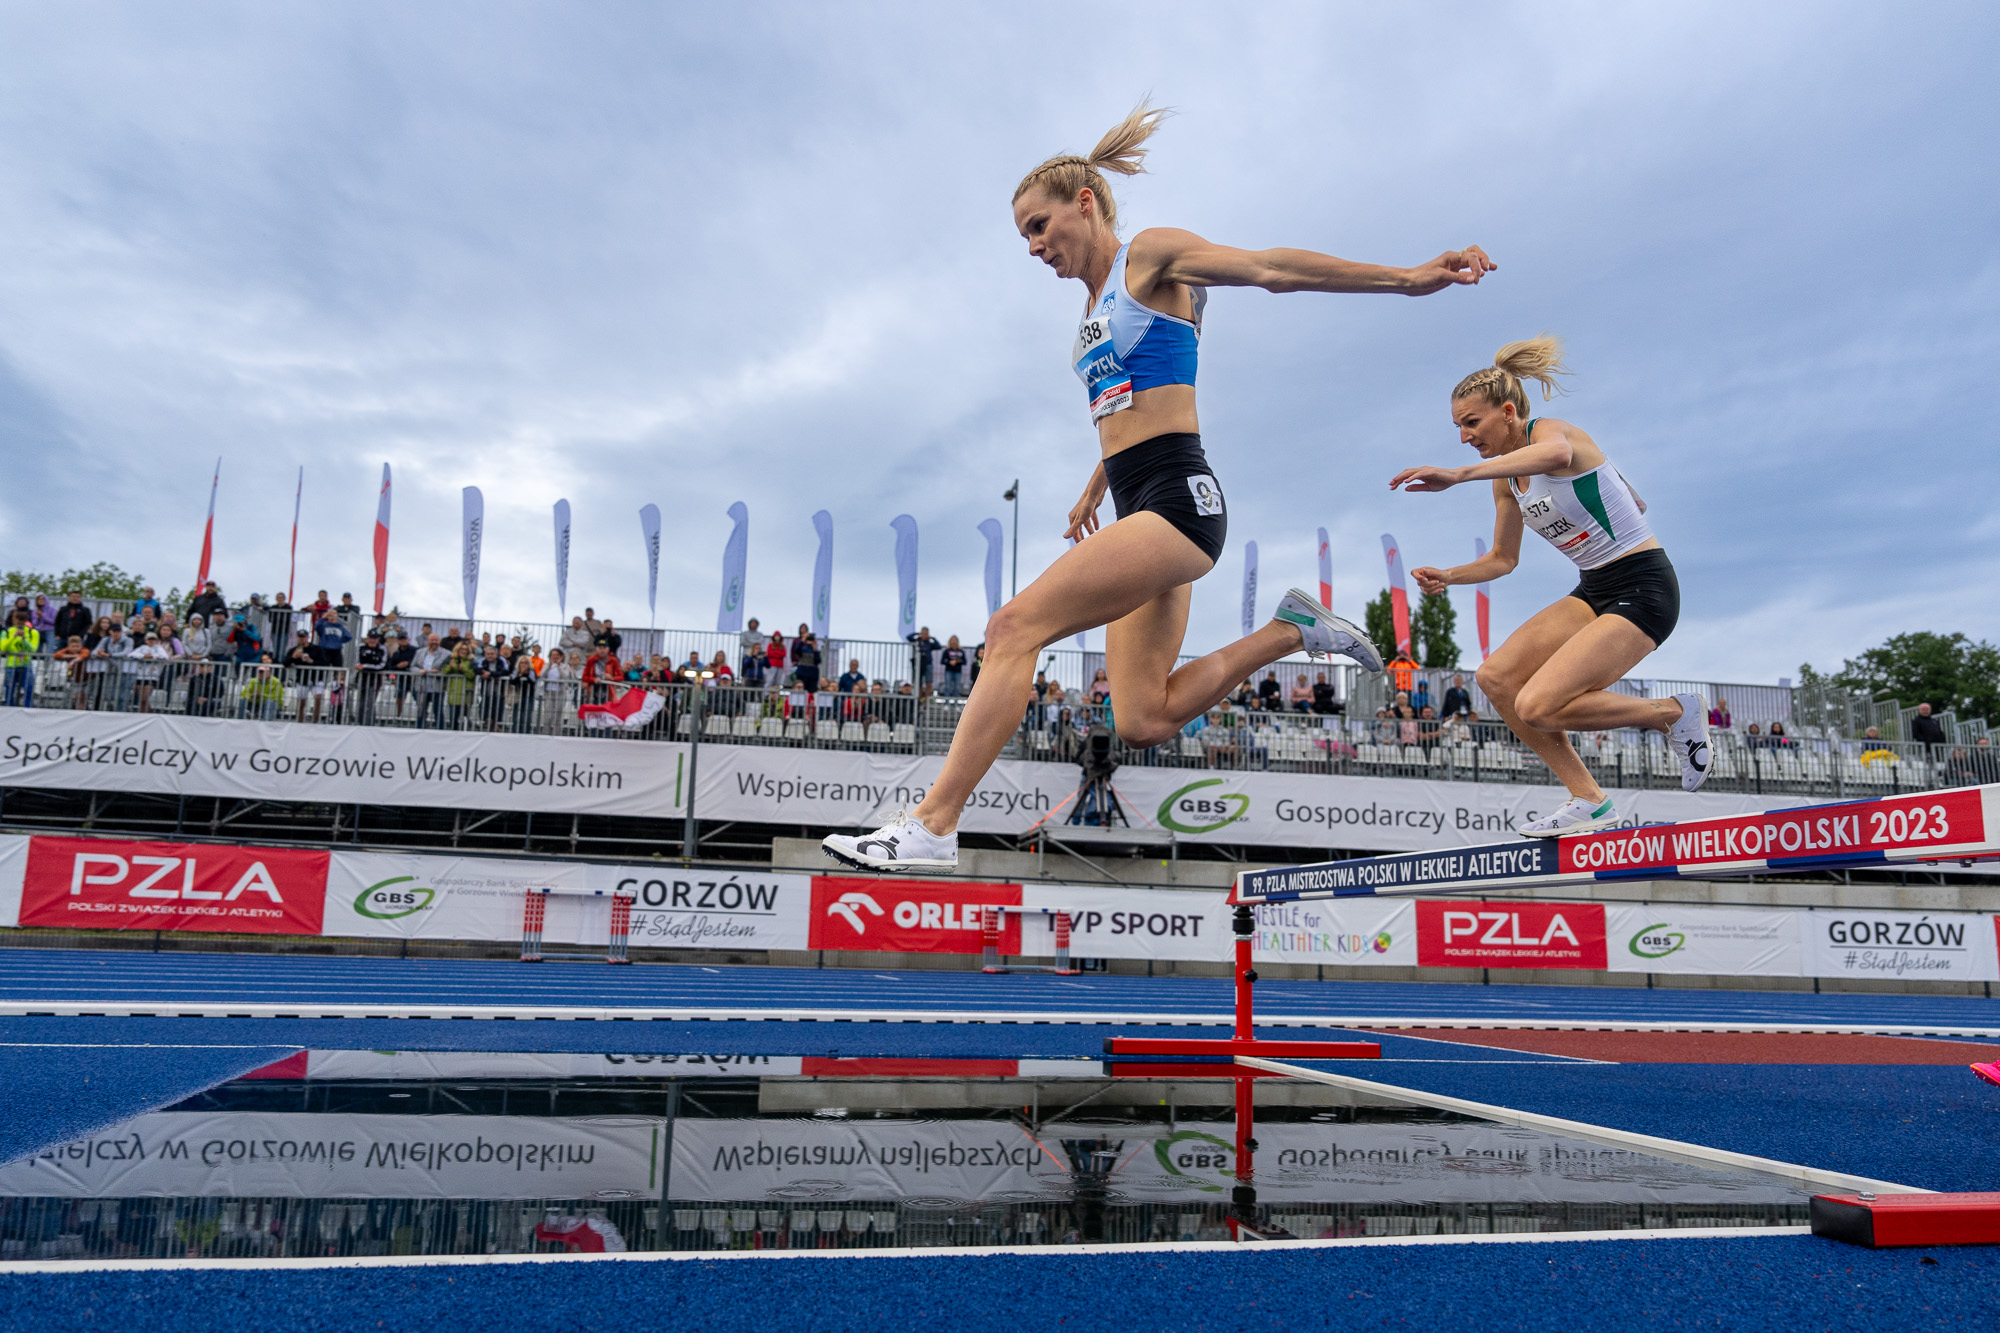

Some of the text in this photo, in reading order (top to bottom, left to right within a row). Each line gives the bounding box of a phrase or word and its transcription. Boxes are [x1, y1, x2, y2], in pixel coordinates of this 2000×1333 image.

[1196, 481, 1213, 509] 9
[1526, 500, 1550, 518] 573
[4, 735, 623, 791] Spółdzielczy w Gorzowie Wielkopolskim
[737, 771, 1050, 815] Wspieramy napszych
[1180, 799, 1227, 814] GBS
[1275, 799, 1445, 834] Gospodarczy
[1456, 807, 1519, 832] Bank
[1571, 830, 1666, 868] GORZÓW
[1671, 813, 1861, 860] WIELKOPOLSKI
[1869, 804, 1950, 845] 2023
[70, 852, 284, 903] PZLA
[430, 876, 485, 887] Gospodarczy
[1252, 847, 1542, 893] 99. PZLA MISTRZOSTWA POLSKI W LEKKIEJ ATLETYCE
[374, 892, 415, 904] GBS
[616, 875, 779, 910] GORZÓW
[68, 902, 116, 913] POLSKI
[178, 905, 226, 917] LEKKIEJ
[229, 908, 284, 918] ATLETYKI
[1304, 912, 1321, 928] for
[1111, 911, 1204, 937] SPORT
[1443, 911, 1580, 946] PZLA
[1828, 916, 1964, 946] GORZÓW
[1252, 931, 1370, 953] HEALTHIER KIDS
[1444, 948, 1474, 957] POLSKI
[1642, 936, 1671, 946] GBS
